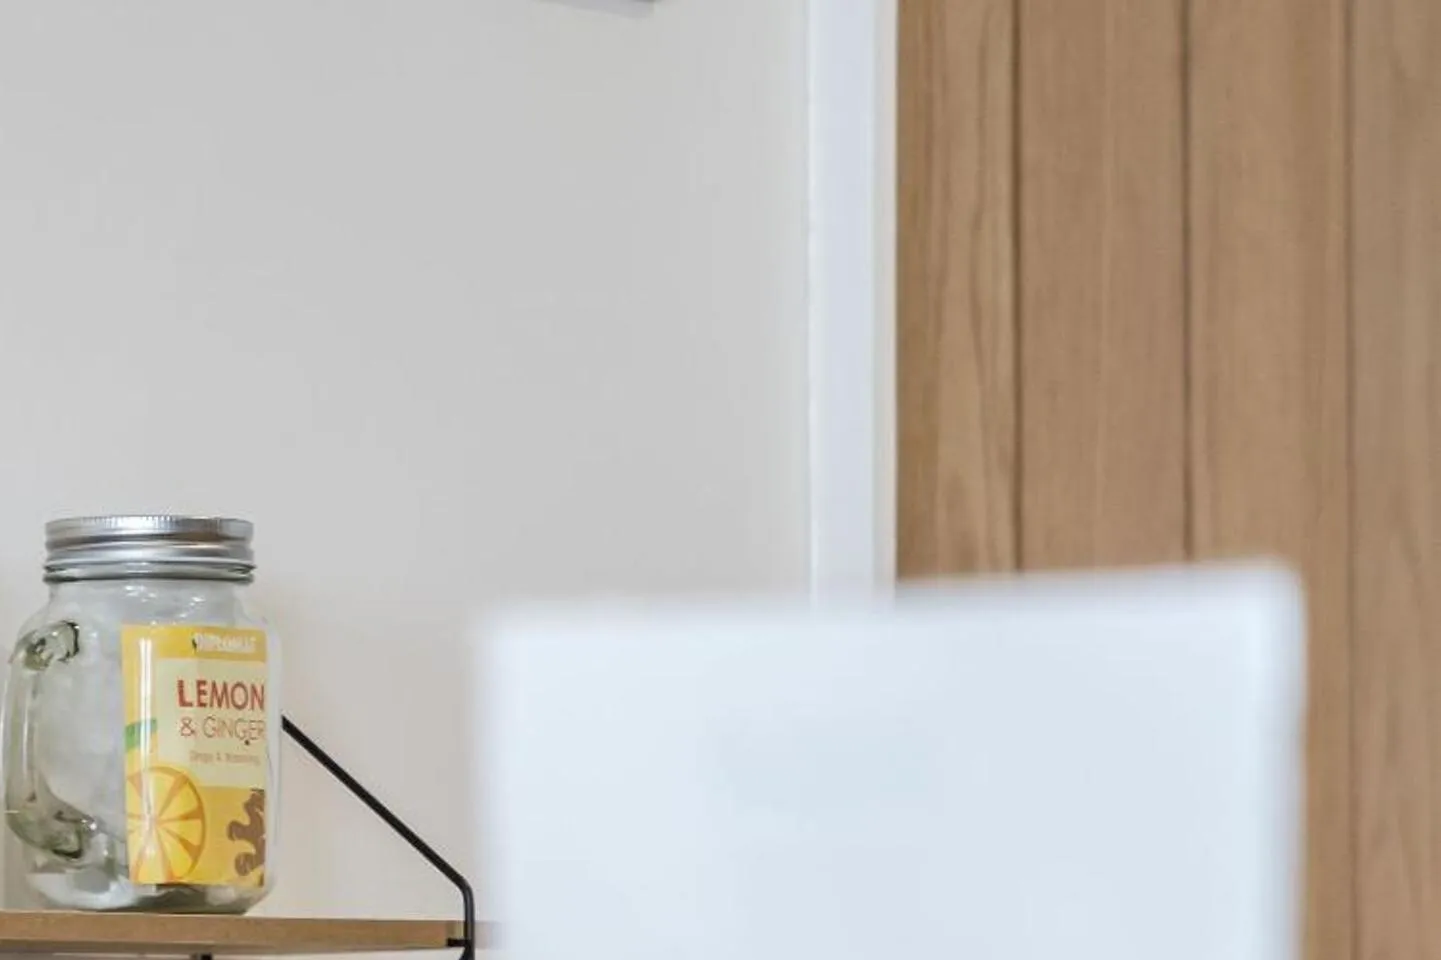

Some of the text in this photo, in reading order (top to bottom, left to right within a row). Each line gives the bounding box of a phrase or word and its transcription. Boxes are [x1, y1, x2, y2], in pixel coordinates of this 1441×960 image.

[177, 679, 265, 711] LEMON
[179, 716, 266, 741] & GINGER
